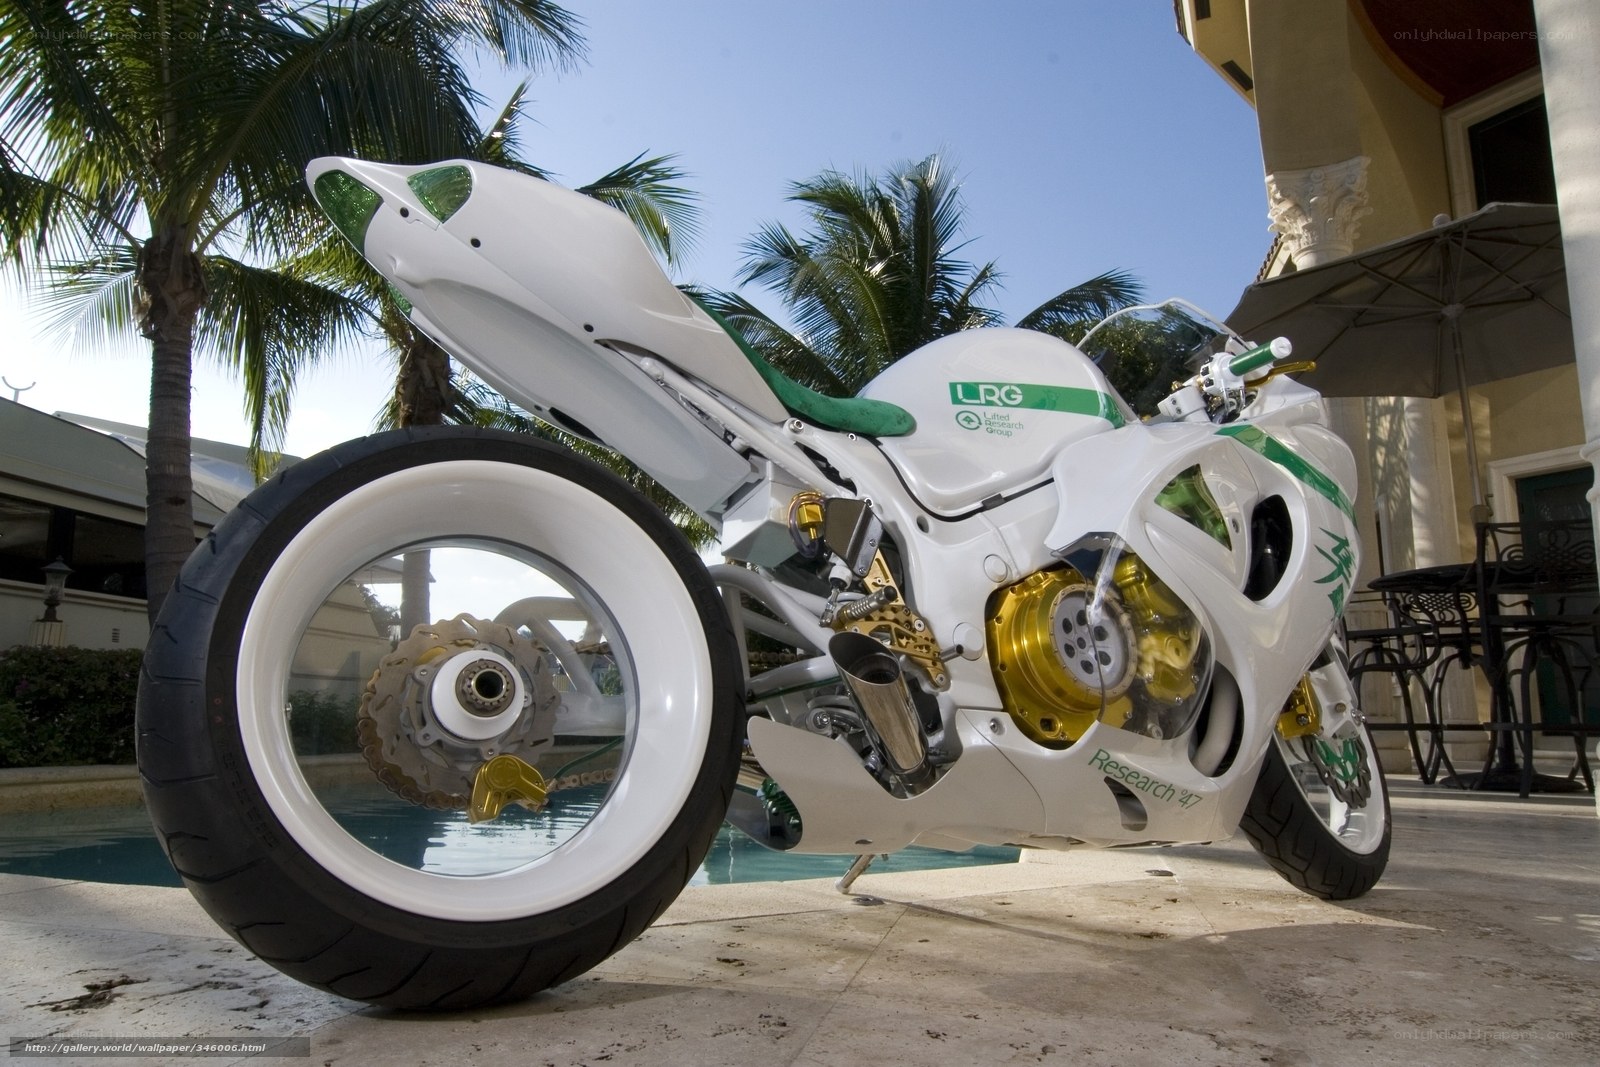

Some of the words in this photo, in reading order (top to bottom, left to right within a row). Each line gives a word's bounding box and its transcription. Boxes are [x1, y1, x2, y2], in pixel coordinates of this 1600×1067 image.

[956, 383, 1023, 406] LRG
[983, 411, 1010, 421] Lifted
[985, 419, 1024, 430] Research
[986, 427, 1013, 437] Group
[1088, 748, 1176, 802] Research
